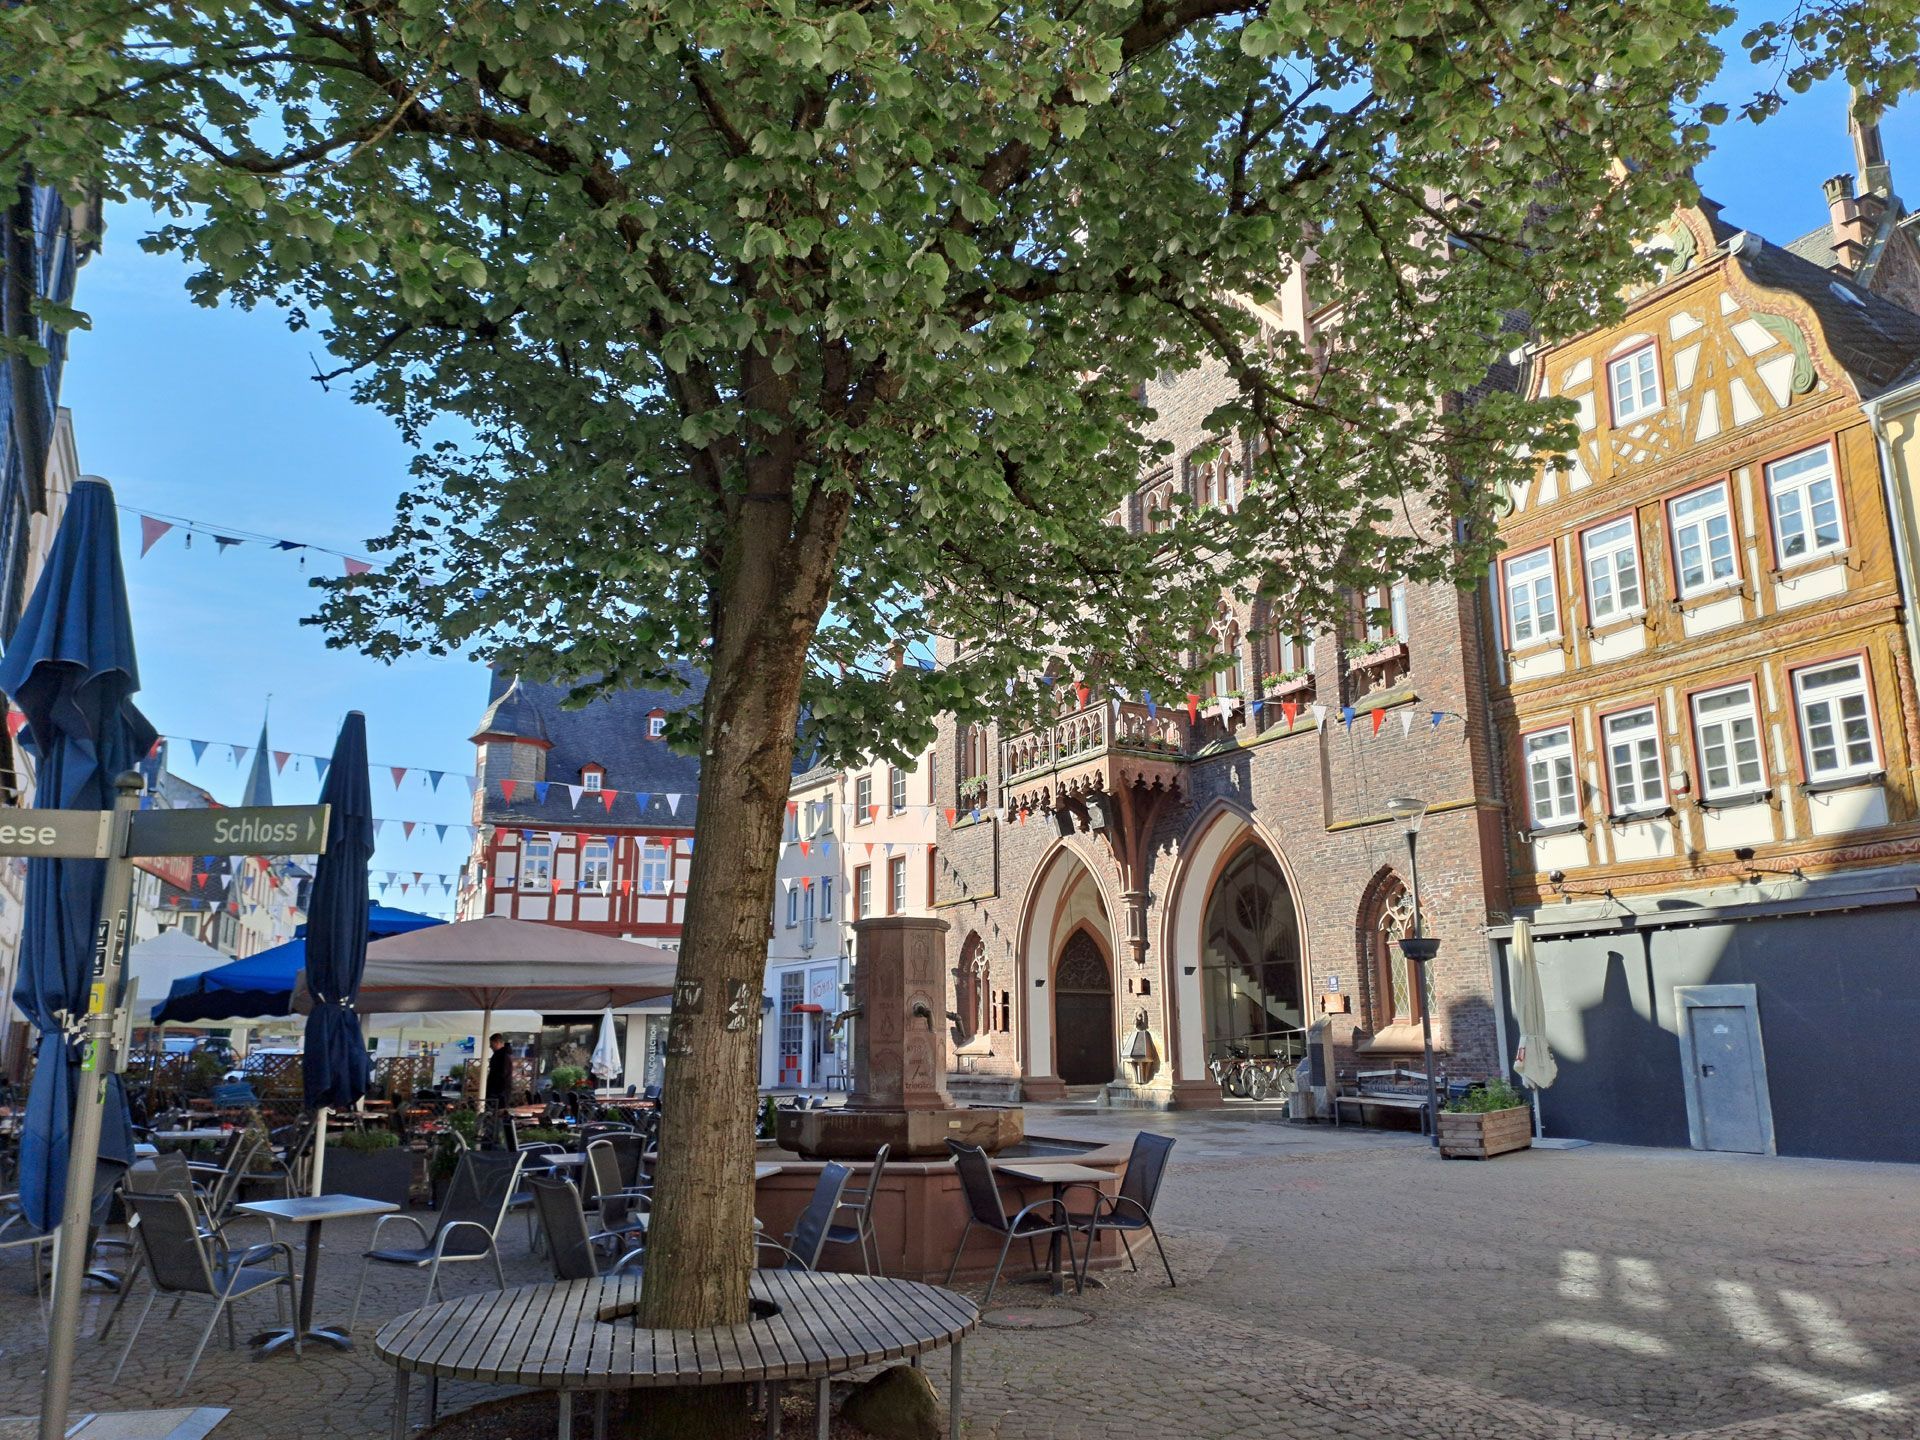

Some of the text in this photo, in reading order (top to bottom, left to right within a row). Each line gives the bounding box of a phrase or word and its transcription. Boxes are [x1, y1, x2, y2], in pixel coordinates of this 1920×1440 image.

[0, 825, 57, 846] ese
[213, 817, 298, 843] Schloss
[648, 1024, 657, 1069] COLLECTION
